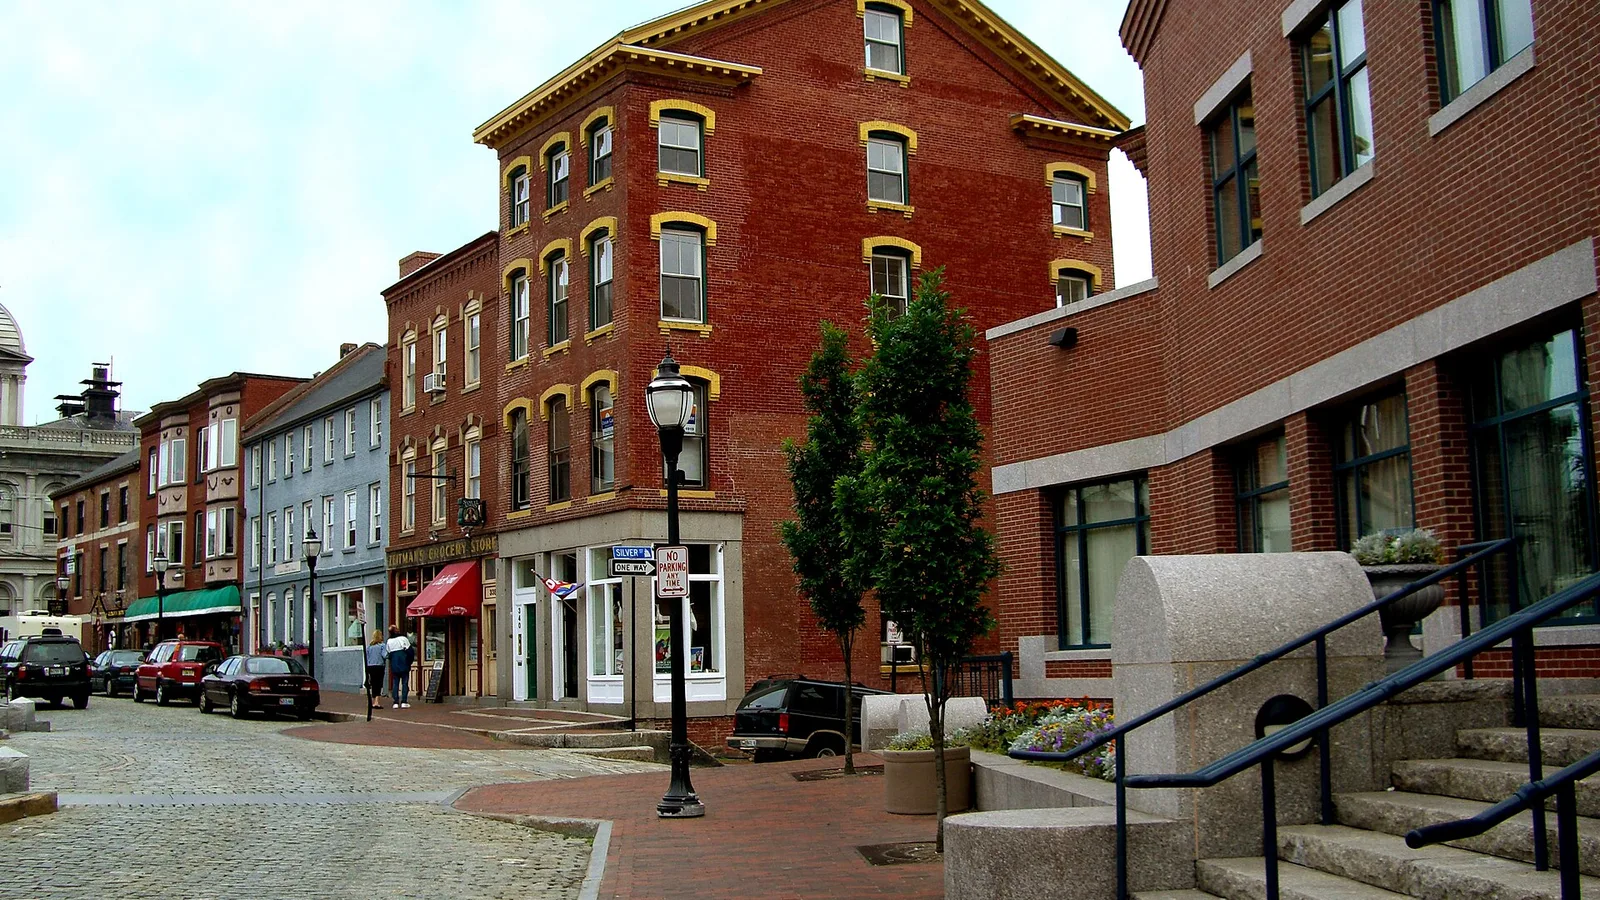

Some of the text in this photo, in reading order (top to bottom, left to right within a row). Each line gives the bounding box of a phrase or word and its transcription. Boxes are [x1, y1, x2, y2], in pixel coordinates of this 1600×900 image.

[428, 541, 467, 560] GROCERY
[470, 536, 497, 553] STORE
[615, 548, 639, 557] SILVER
[666, 551, 679, 561] NO
[616, 563, 648, 571] ONE WAY
[660, 562, 686, 572] PARKING
